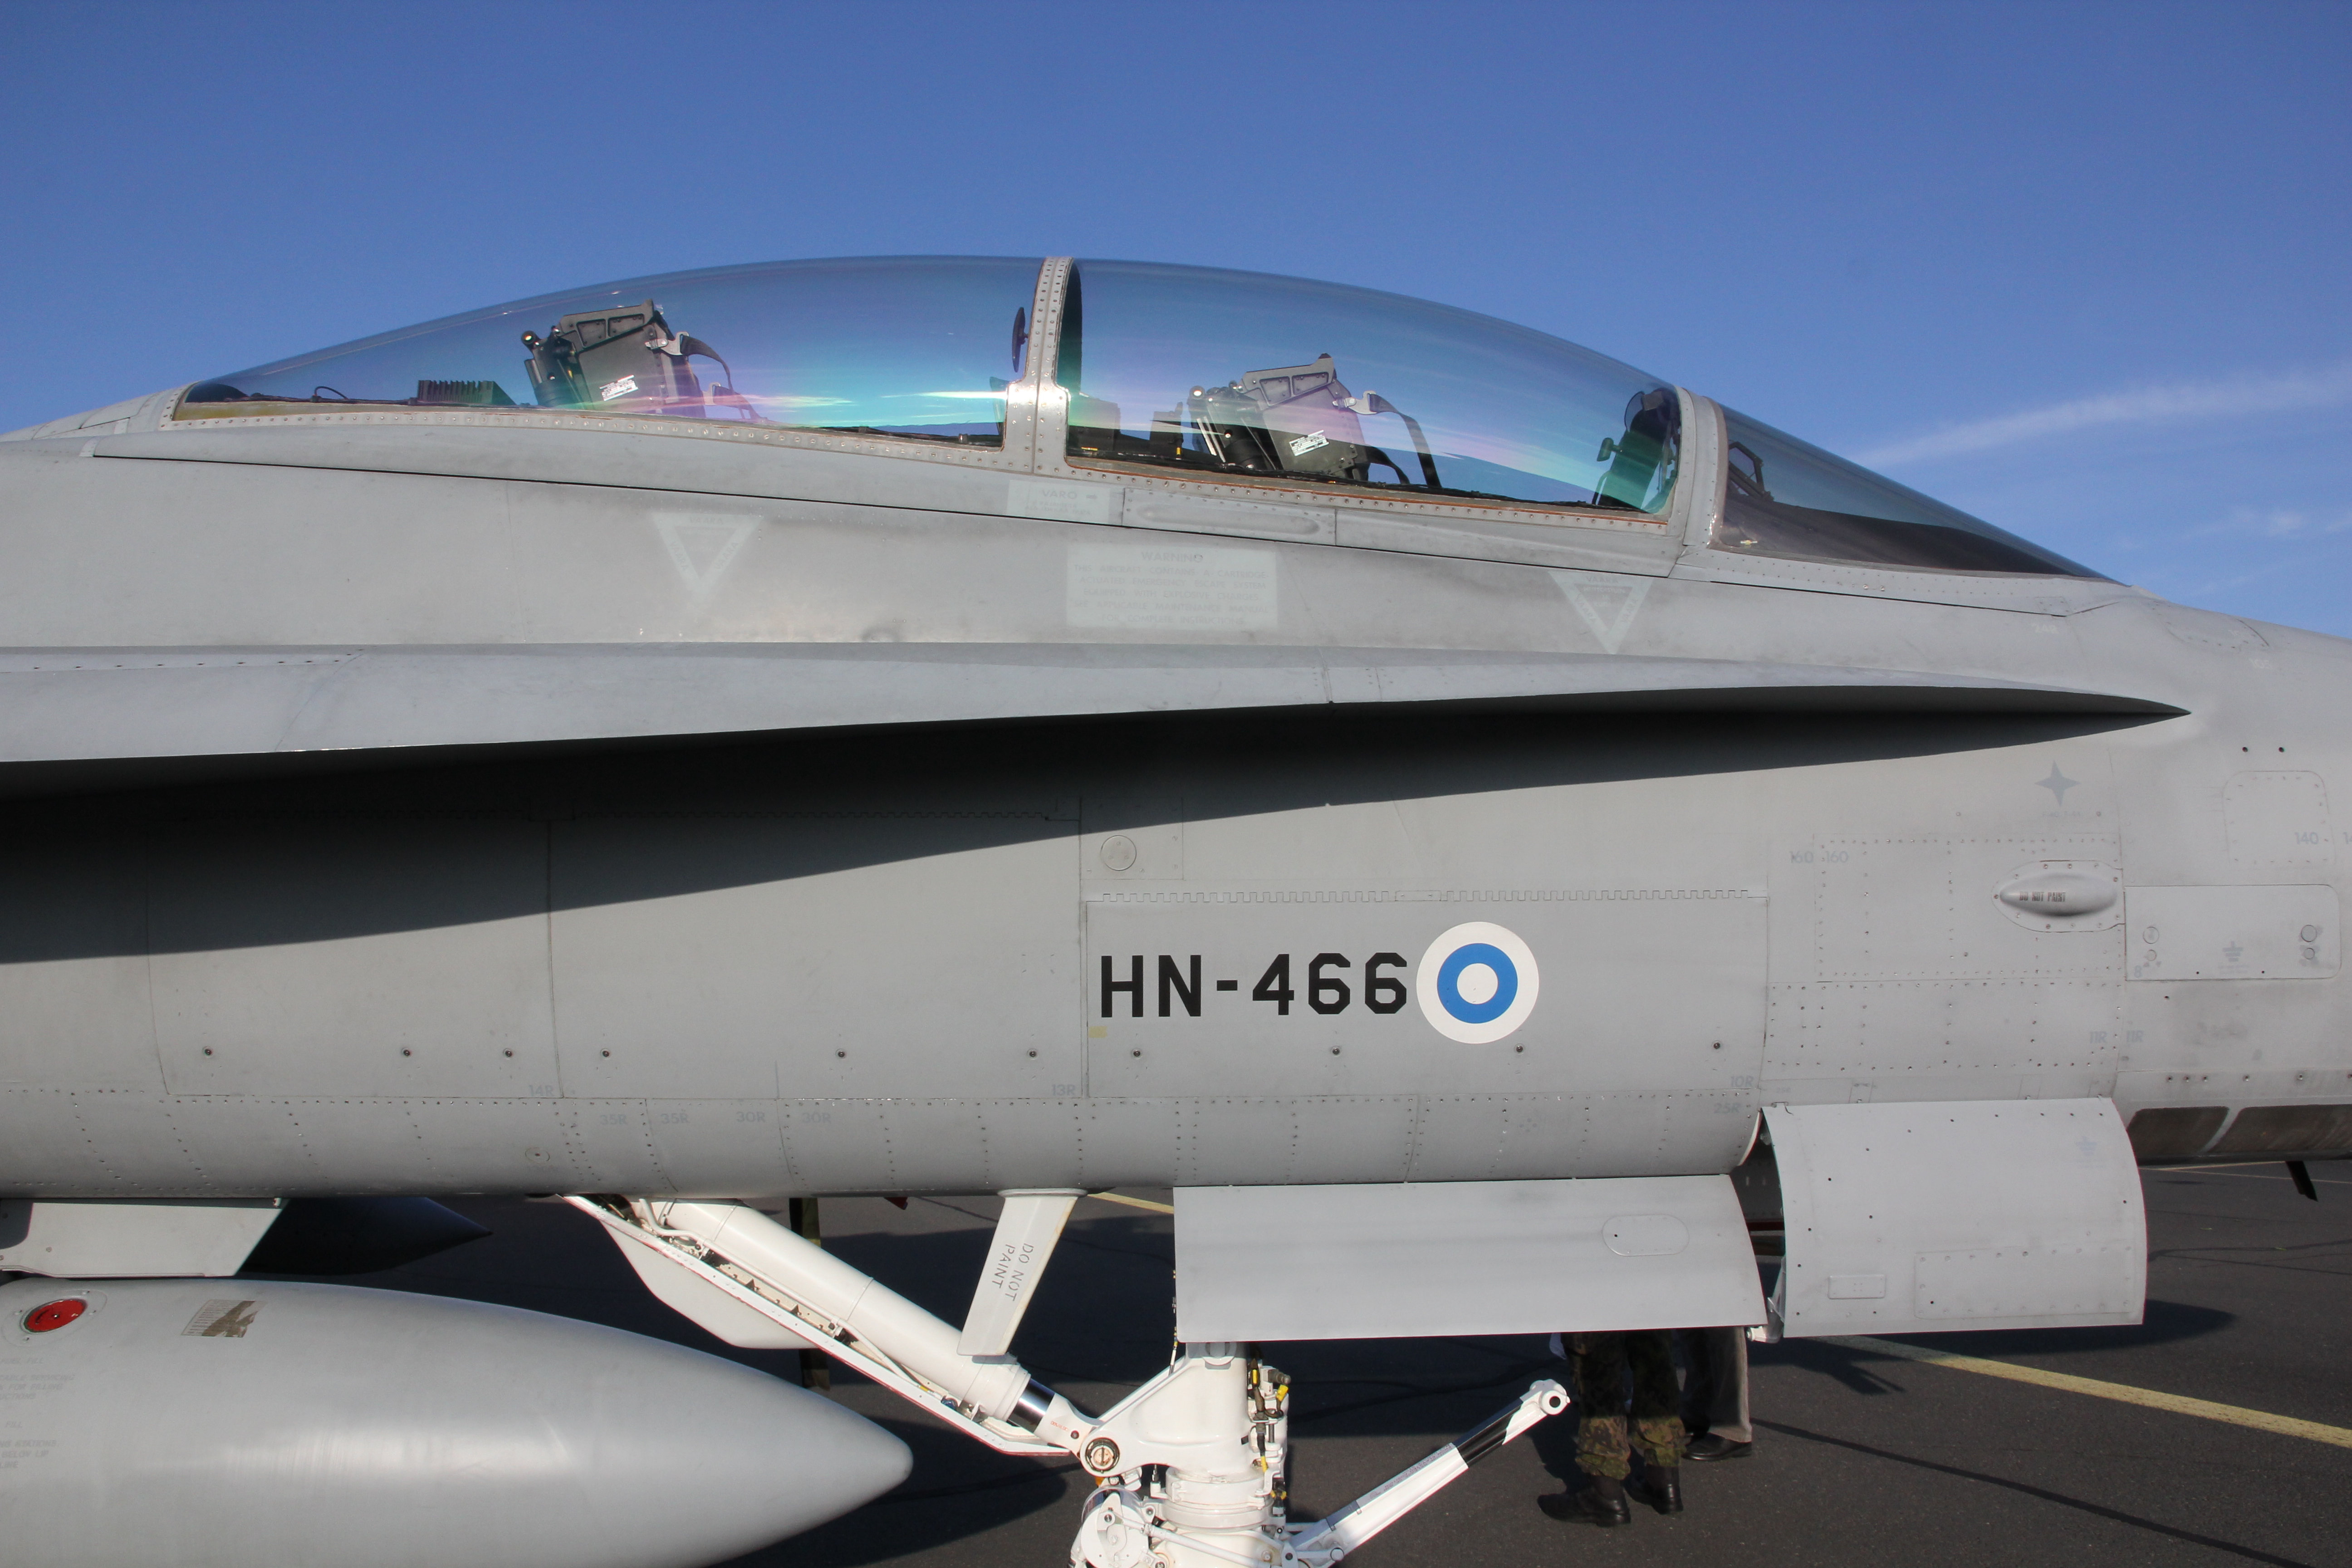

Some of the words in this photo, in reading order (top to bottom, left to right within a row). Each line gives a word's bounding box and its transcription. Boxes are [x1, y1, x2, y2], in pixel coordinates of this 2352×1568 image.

[1042, 490, 1078, 500] VARO
[689, 516, 724, 525] VAARA
[670, 541, 689, 572] VAARA
[714, 542, 740, 570] VAARA
[1141, 551, 1203, 563] WARNING
[1099, 565, 1141, 573] AIRCRAFT
[1149, 567, 1196, 576] CONTAINS
[1132, 578, 1186, 586] EMERGENCY
[1194, 580, 1226, 588] ESCAPE
[1083, 588, 1126, 596] EQUIPPED
[1163, 590, 1210, 599] EXPLOSIVE
[1217, 592, 1259, 601] CHARGES
[1074, 600, 1088, 608] SEE
[1097, 601, 1147, 610] APPLICABLE
[1155, 603, 1222, 612] MAINTENANCE
[1229, 605, 1269, 613] MANUAL
[1127, 614, 1173, 623] COMPLETE
[1180, 616, 1245, 625] INSTRUCTIONS
[2294, 831, 2319, 845] 140
[1789, 850, 1814, 864] 160
[1825, 850, 1850, 863] 160
[2019, 892, 2029, 902] DO
[2032, 892, 2043, 902] NOT
[2047, 892, 2066, 902] PAINT
[1101, 952, 1407, 1018] HN-466
[2089, 1030, 2107, 1044] 11R
[2126, 1030, 2144, 1043] 11R
[1730, 1075, 1754, 1088] 10R
[529, 1084, 554, 1096] 14R
[1052, 1084, 1076, 1096] 13R
[1714, 1102, 1741, 1114] 25R
[599, 1114, 628, 1126] 35R
[661, 1112, 691, 1125] 35R
[736, 1111, 766, 1123] 30R
[802, 1112, 831, 1124] 30R
[1018, 1243, 1034, 1264] DO
[992, 1244, 1016, 1289] PAINT
[1005, 1270, 1024, 1302] NOT
